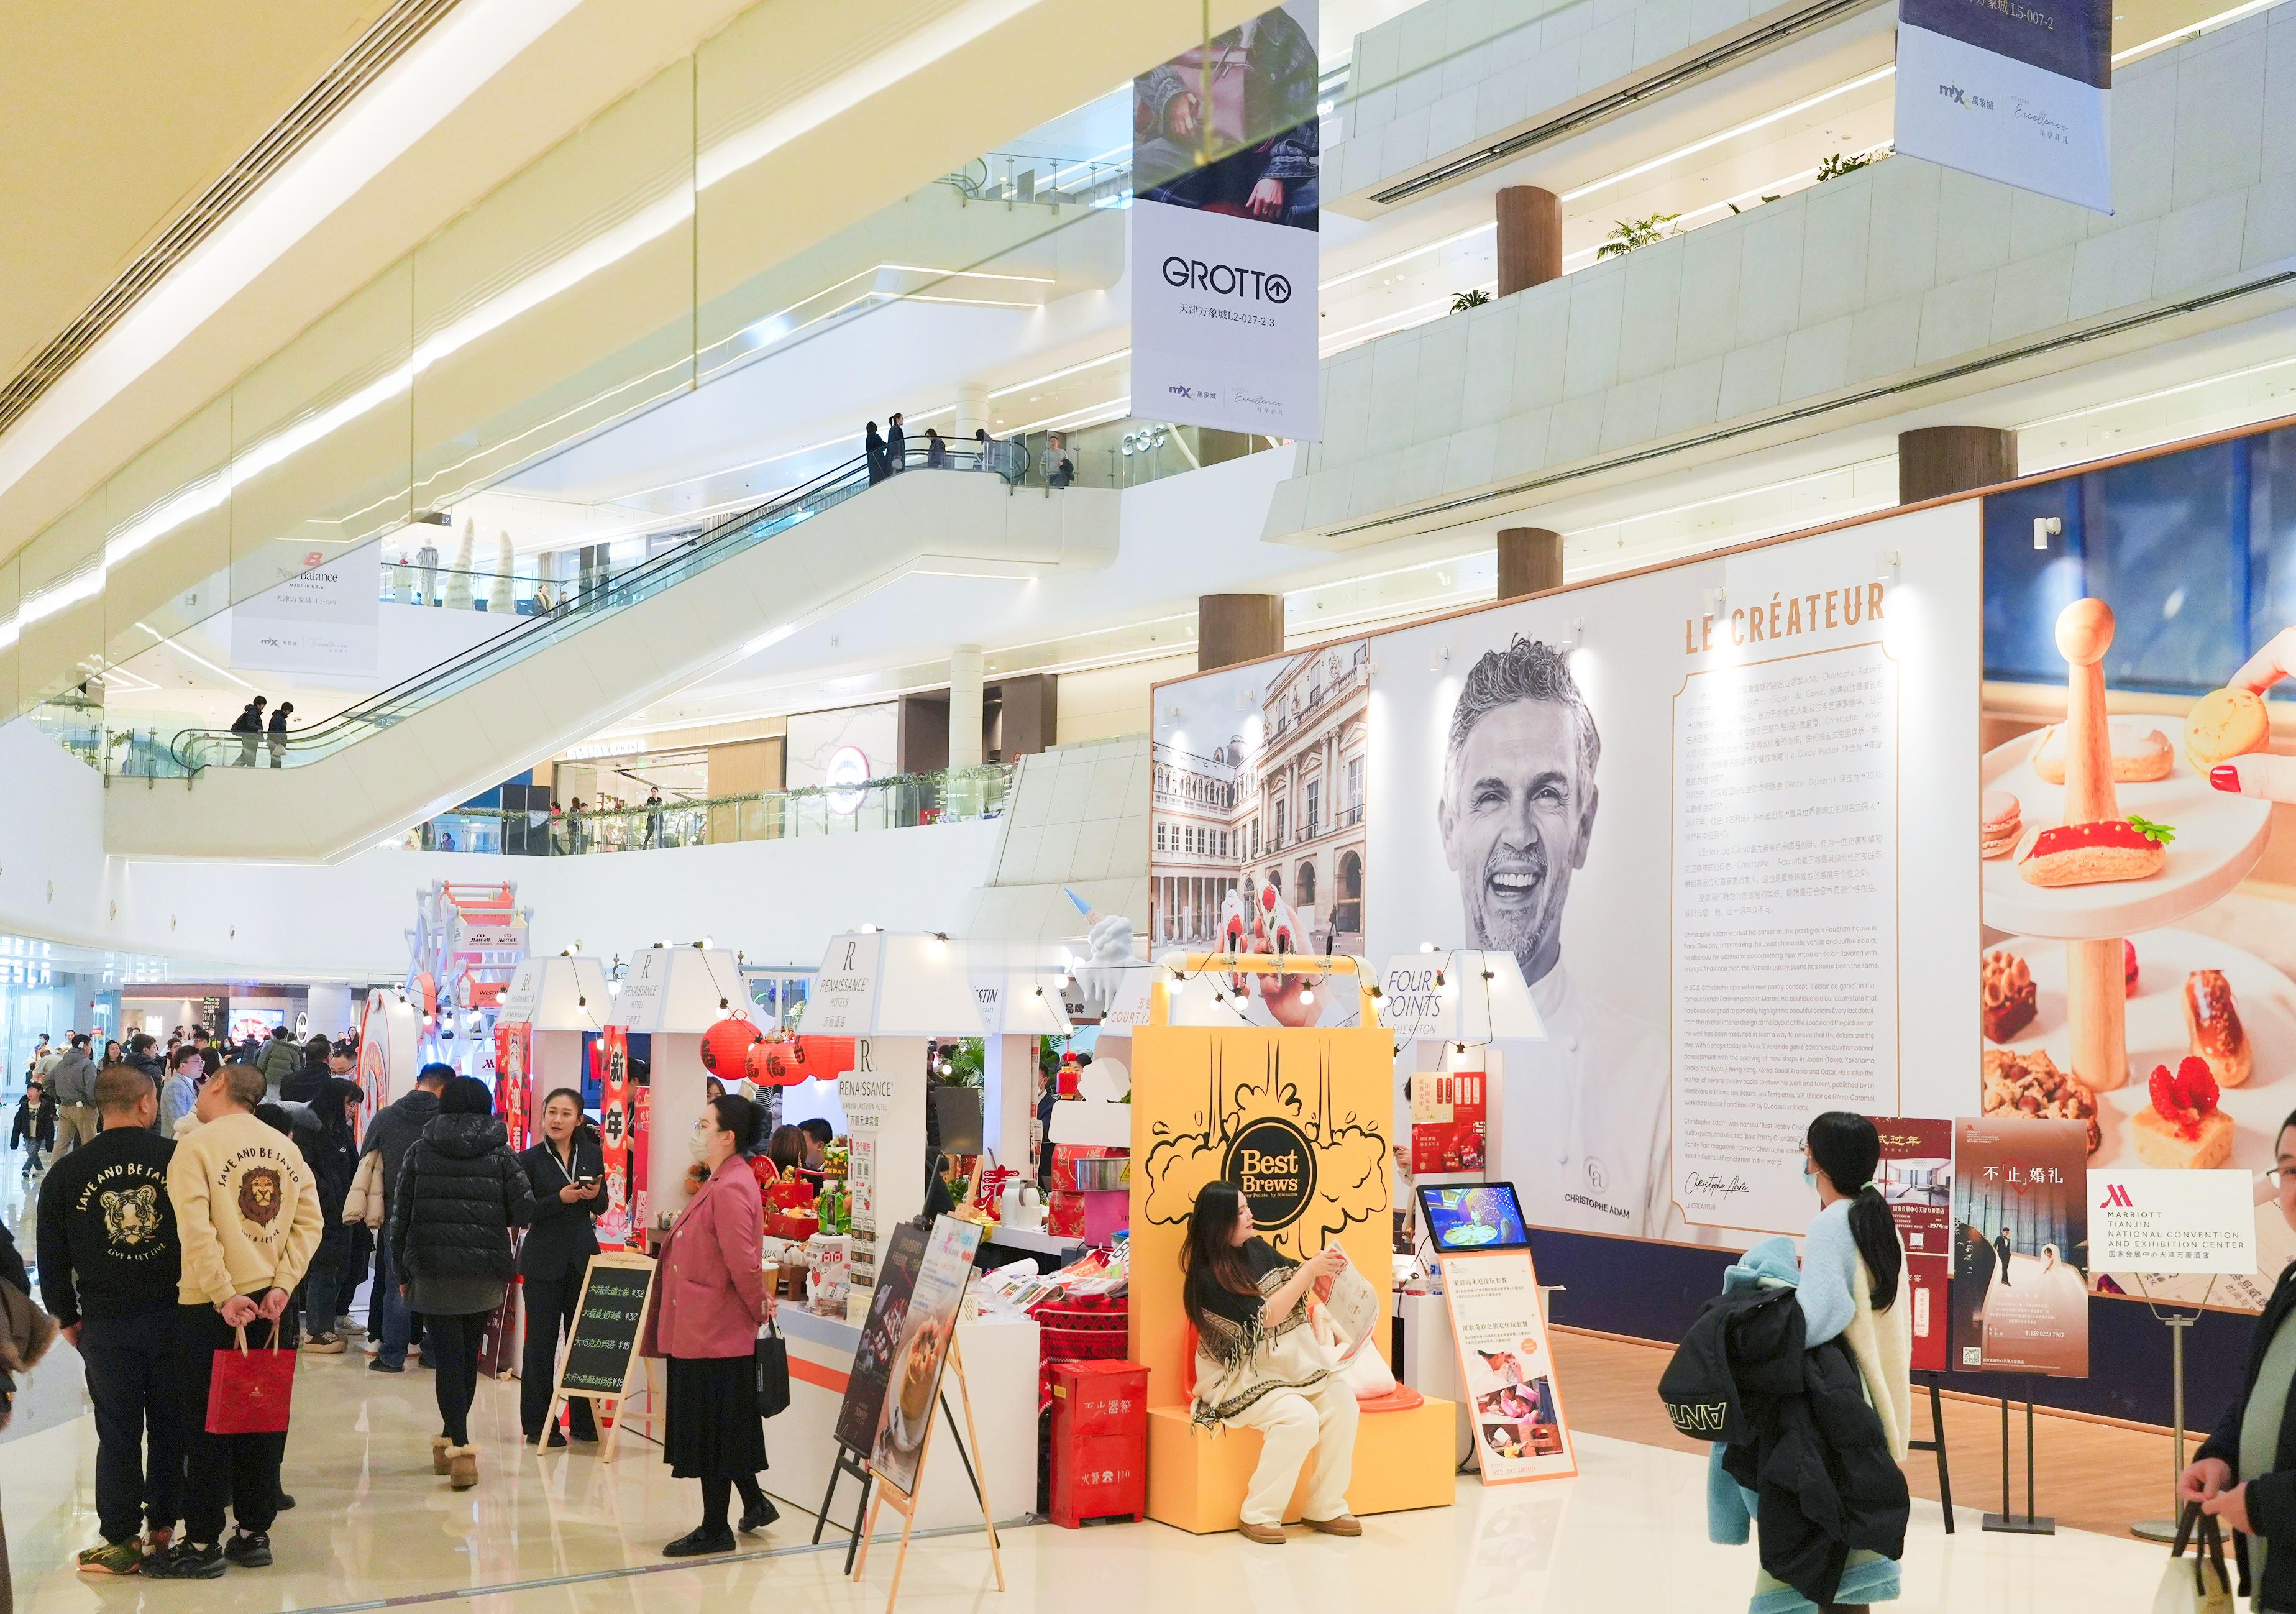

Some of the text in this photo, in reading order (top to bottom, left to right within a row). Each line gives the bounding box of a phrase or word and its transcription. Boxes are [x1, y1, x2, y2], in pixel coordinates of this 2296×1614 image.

[2014, 104, 2068, 131] Excellence
[1163, 256, 1291, 304] GROTTO
[1180, 303, 1274, 328] 天津万象城L2-027-2-3
[1234, 392, 1283, 406] Excellence
[300, 570, 338, 582] Balance
[277, 595, 313, 604] 天津万象城
[1685, 582, 1885, 654] LE CRÉATEUR
[1795, 927, 1824, 935] prestigious
[842, 942, 856, 971] R
[641, 955, 652, 979] R
[820, 978, 867, 993] RENAISSANCE
[1388, 970, 1432, 992] FOUR
[624, 985, 657, 997] RENAISSANCE
[830, 997, 849, 1007] HOTELS
[1383, 996, 1442, 1017] POINTS
[823, 1015, 846, 1028] 万丽酒店
[860, 1040, 873, 1072] R
[839, 1080, 892, 1097] RENAISSANCE
[857, 1103, 875, 1111] LAKEVIEW
[875, 1103, 887, 1111] HOTEL
[850, 1115, 879, 1127] 万丽天津宾馆
[219, 1147, 299, 1188] SAVE AND BE SAVED
[1240, 1149, 1299, 1175] Best
[76, 1182, 97, 1213] SAVE
[97, 1165, 124, 1183] AND
[127, 1163, 144, 1175] BE
[1241, 1175, 1298, 1193] Brews
[1565, 1194, 1630, 1219] CHRISTOPHE ADAM
[1691, 1202, 1716, 1211] CREATEUR
[261, 1236, 272, 1244] LET
[2167, 1231, 2239, 1239] CONVENTION
[135, 1252, 149, 1260] LET
[2108, 1250, 2210, 1259] 国家会展中心天津万豪酒店
[1453, 1277, 1507, 1286] 家庭周末吃住玩套餐
[1462, 1321, 1529, 1332] 探索奇妙之旅吃住玩套餐
[618, 1341, 631, 1350] ¥16
